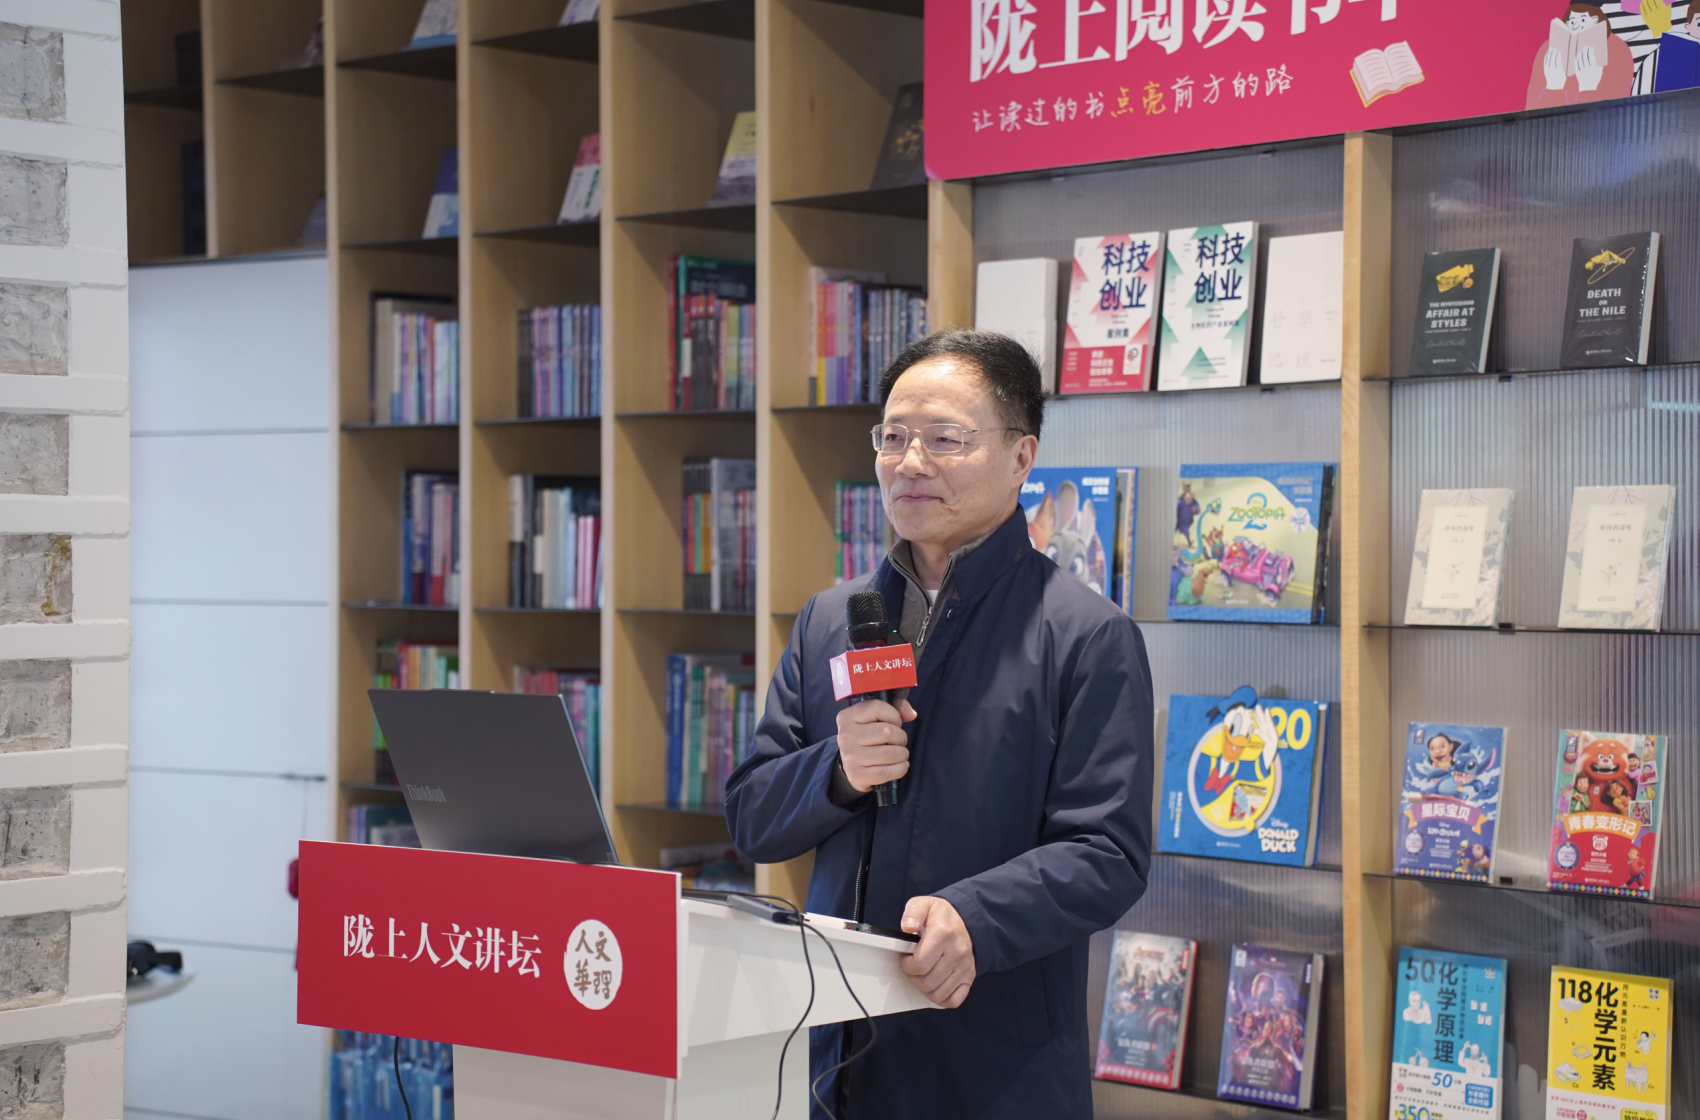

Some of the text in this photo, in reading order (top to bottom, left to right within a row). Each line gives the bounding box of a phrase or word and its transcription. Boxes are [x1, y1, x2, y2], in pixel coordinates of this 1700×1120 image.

[968, 0, 1398, 83] 陇上阅读
[972, 63, 1294, 133] 让读过的书点亮前方的路
[1101, 240, 1151, 276] 科技
[1195, 232, 1245, 268] 科技
[1099, 277, 1147, 311] 创业
[1194, 268, 1243, 304] 创业
[1587, 288, 1622, 299] DEATH
[1425, 307, 1476, 319] AFFAIR AT
[1579, 305, 1627, 318] THE NILE
[1430, 318, 1468, 329] STYLES
[1227, 507, 1286, 522] ZOOTOPIA
[852, 657, 913, 675] 陇上人文讲坛
[405, 784, 447, 802] ThinkBook
[1421, 803, 1471, 821] 星际宝贝
[1258, 827, 1299, 841] DONALD
[1568, 814, 1637, 837] 青春变形记
[1261, 839, 1297, 853] DUCK
[343, 914, 542, 978] 陇上人文讲坛
[1405, 957, 1435, 982] 50
[1557, 978, 1593, 1003] 118
[1433, 960, 1459, 1064] 化学原理
[1619, 983, 1629, 1058] 用元素重新认识万物
[1592, 981, 1619, 1091] 化学元素
[1431, 1072, 1453, 1088] 50
[1398, 1104, 1430, 1120] 350
